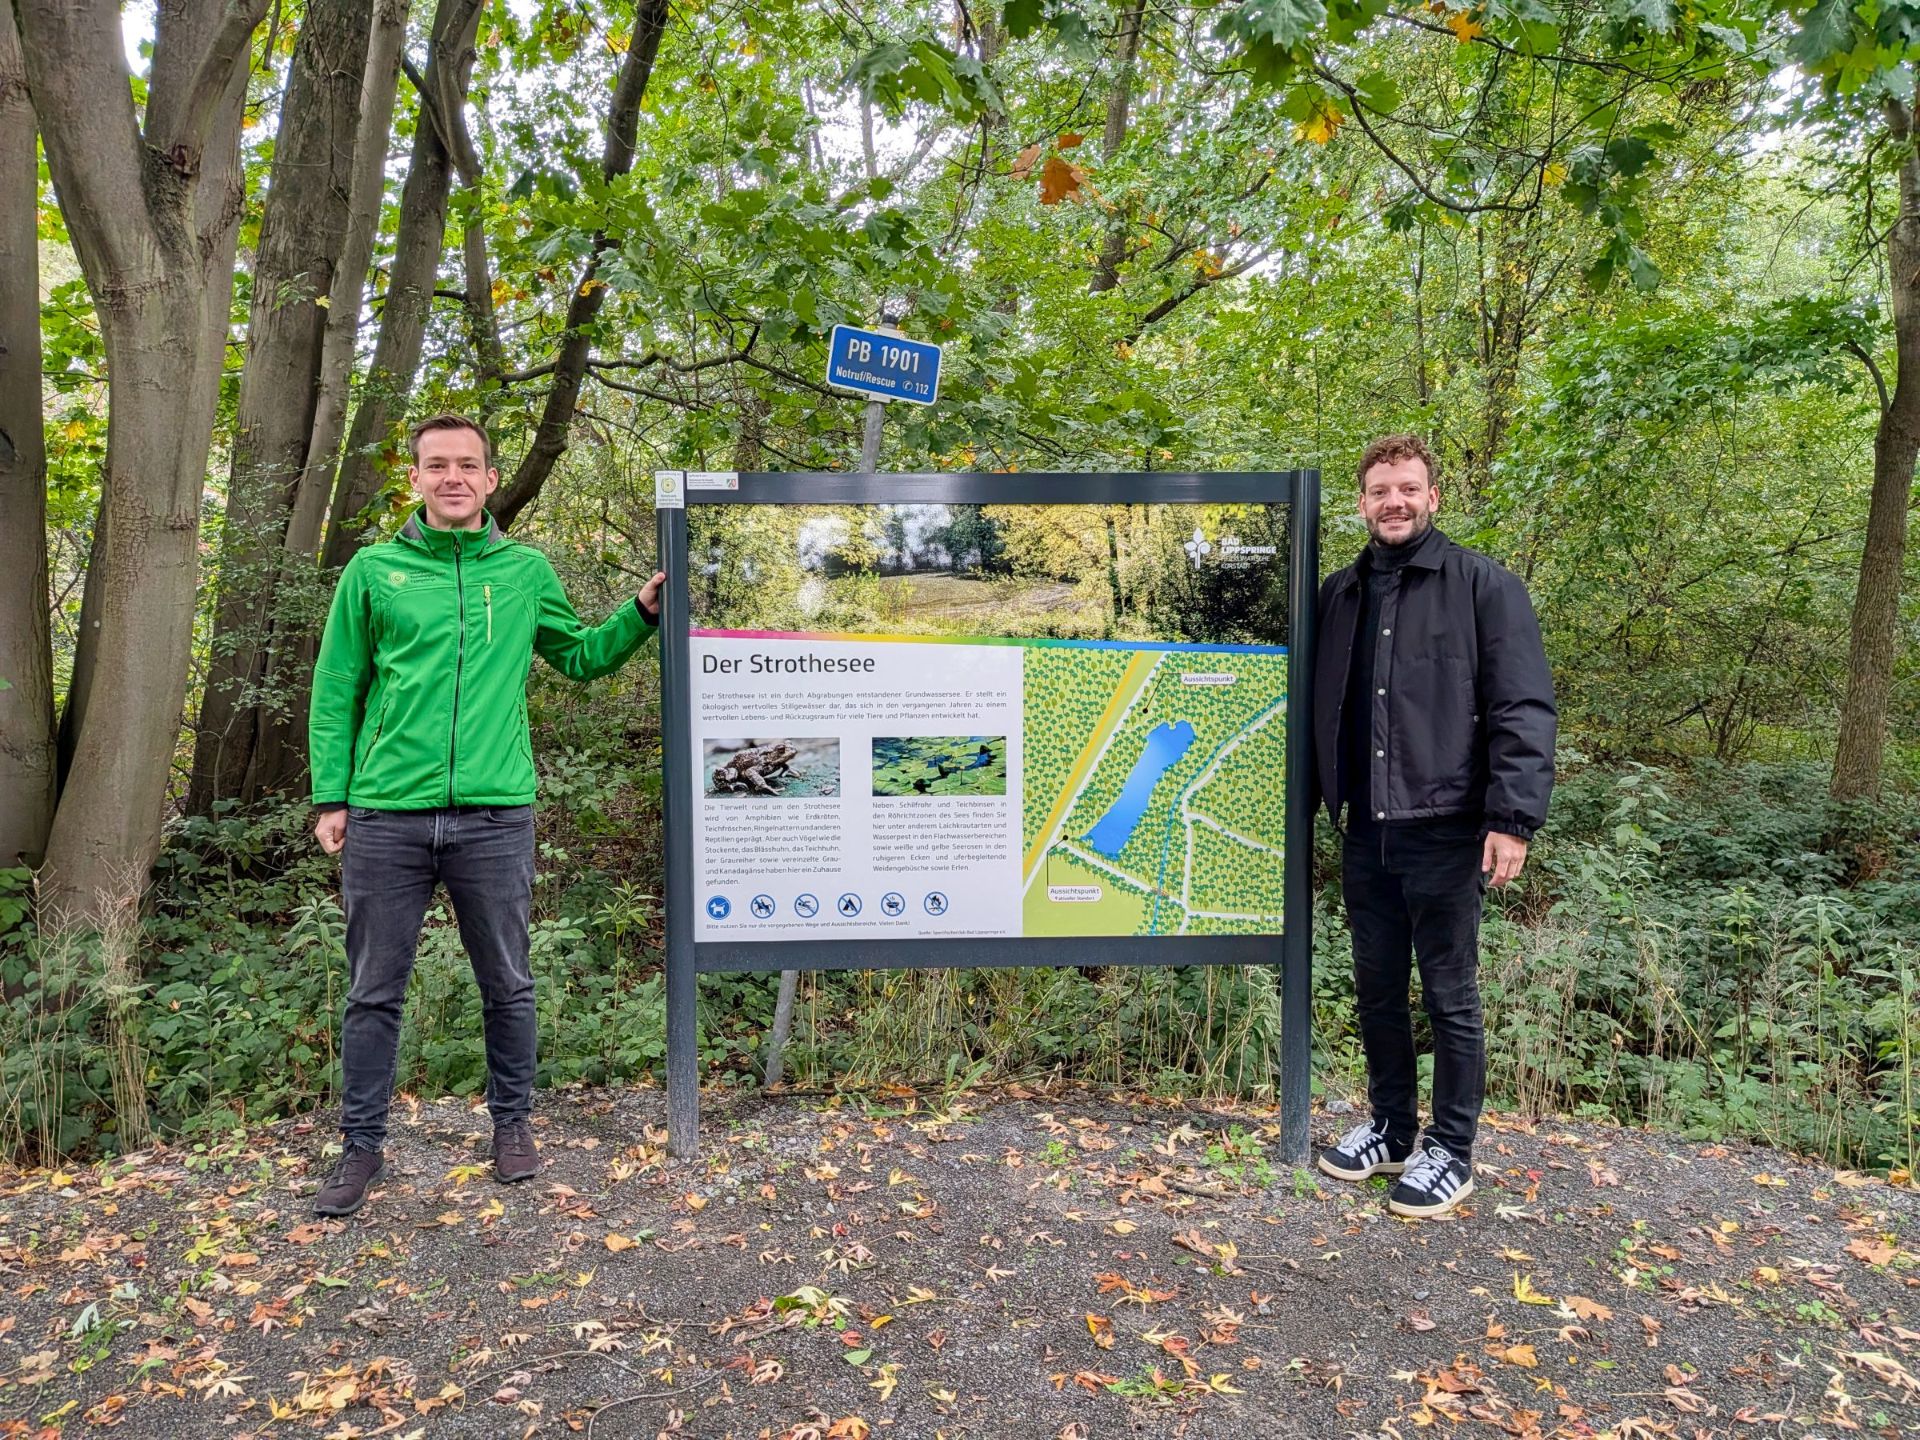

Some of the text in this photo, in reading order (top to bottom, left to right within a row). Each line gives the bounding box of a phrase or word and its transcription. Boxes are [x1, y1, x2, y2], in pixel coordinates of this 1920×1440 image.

[848, 338, 920, 373] PB 1901
[836, 366, 929, 395] Notruf/Rescue 112
[702, 653, 875, 673] Der Strothesee
